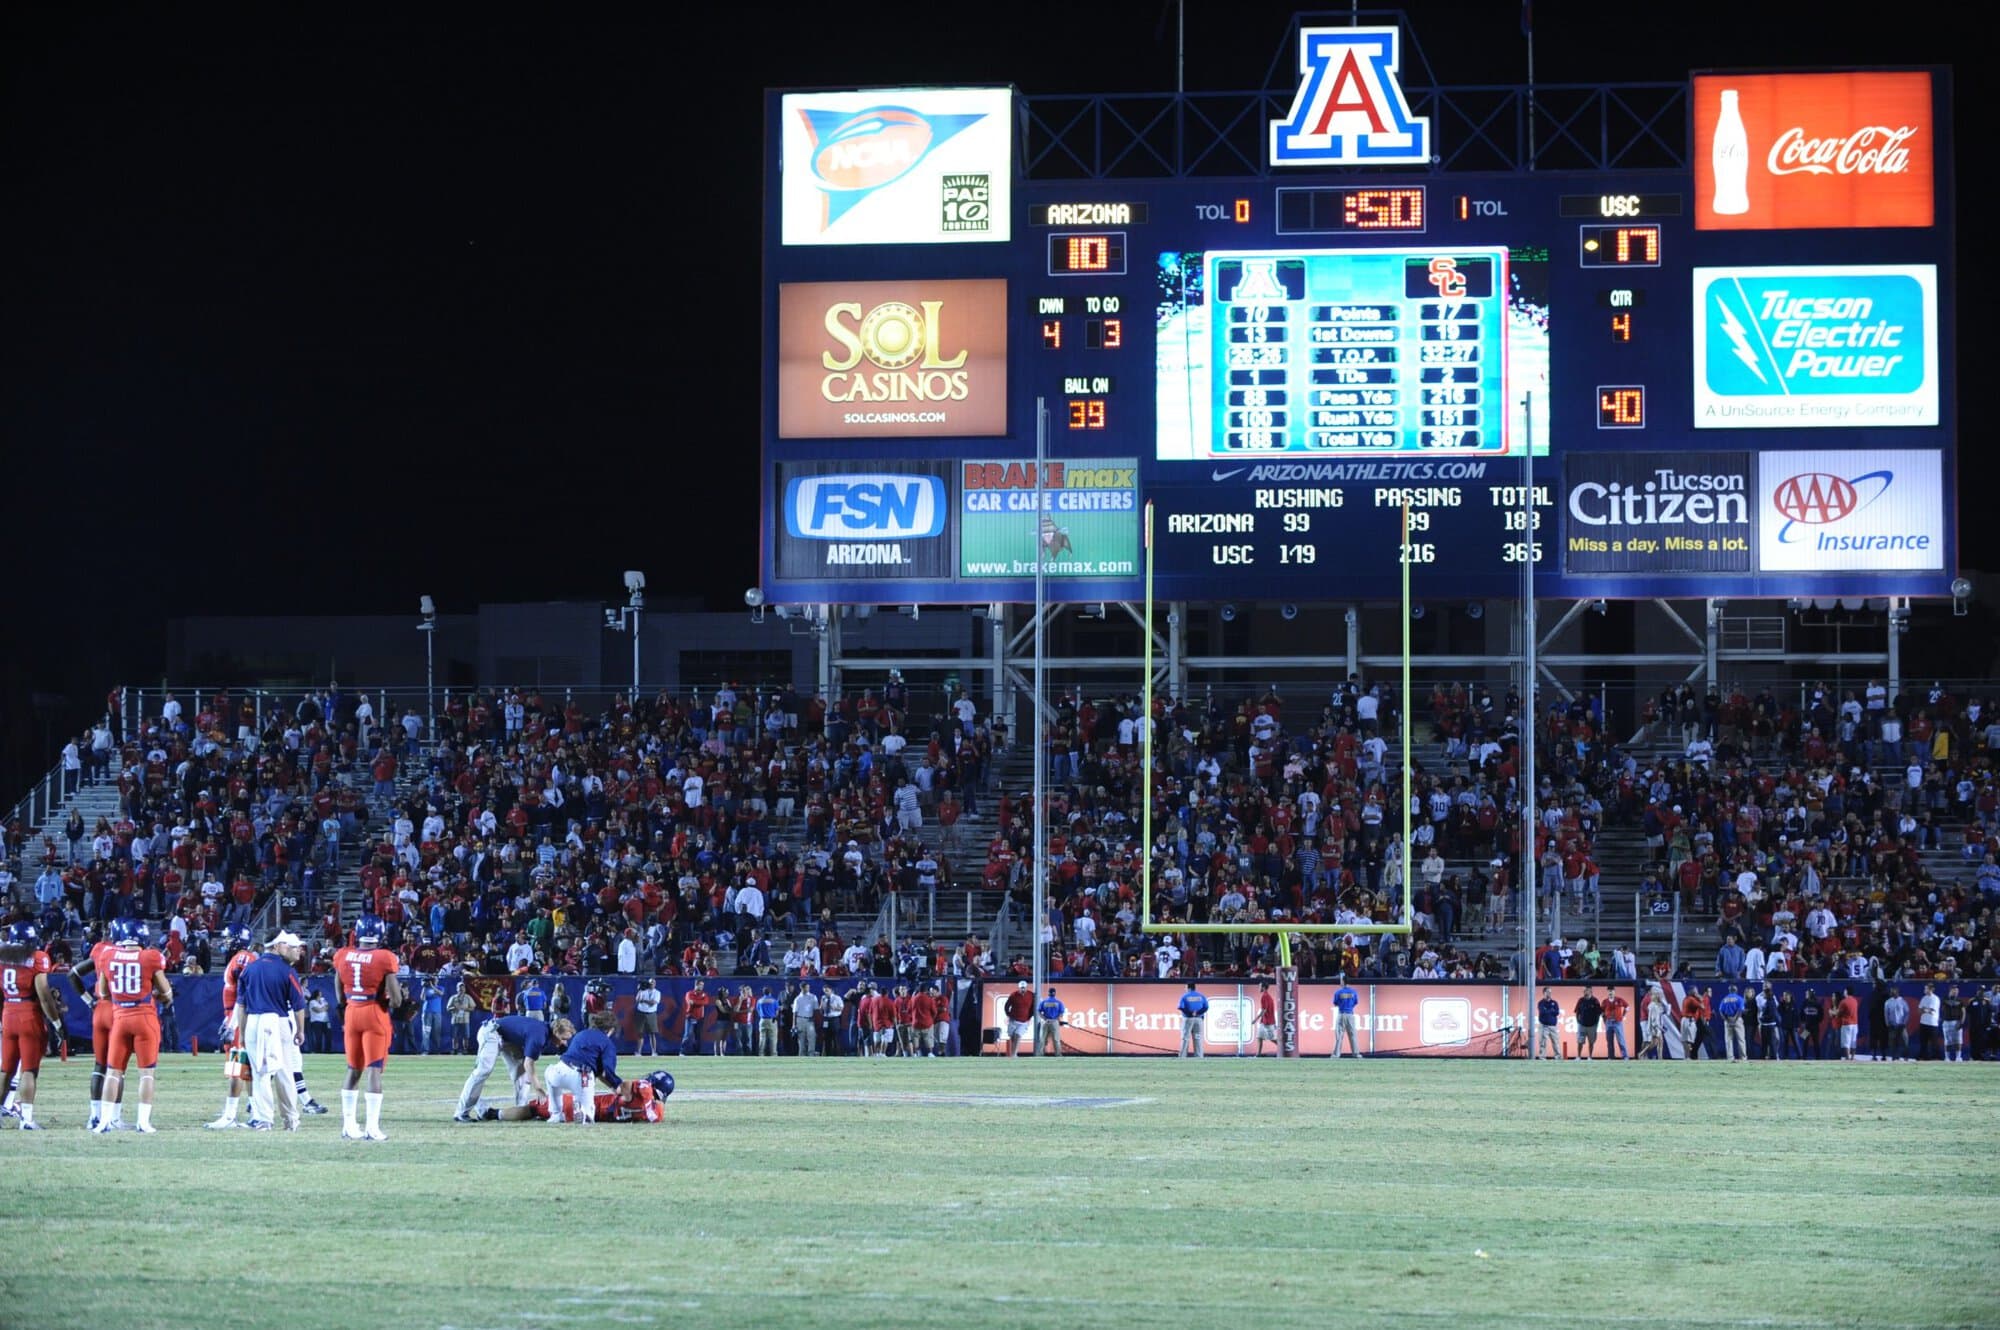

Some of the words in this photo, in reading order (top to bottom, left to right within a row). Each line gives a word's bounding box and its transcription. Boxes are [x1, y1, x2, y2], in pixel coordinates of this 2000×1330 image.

[1270, 26, 1429, 166] A
[1767, 126, 1918, 175] Coca-Cola
[943, 187, 988, 201] PAC
[943, 202, 988, 221] 10
[1048, 205, 1129, 224] ARIZONA
[1196, 205, 1230, 220] TOL
[1472, 201, 1507, 216] TOL
[1600, 196, 1640, 216] USC
[1068, 238, 1107, 269] 10
[1617, 229, 1658, 262] 17
[1039, 298, 1063, 313] DWN
[1086, 298, 1100, 313] TO
[1103, 298, 1119, 313] GO
[1610, 290, 1632, 306] QTR
[1760, 289, 1873, 320] Tucson
[1244, 304, 1269, 322] 10
[1330, 306, 1380, 321] Points
[1436, 303, 1461, 320] 17
[822, 300, 968, 371] SOL
[1043, 321, 1061, 348] 4
[1103, 320, 1121, 347] 3
[1313, 327, 1338, 342] 1st
[1340, 326, 1393, 341] Downs
[1612, 313, 1630, 340] 4
[1771, 319, 1904, 348] Electric
[1331, 349, 1379, 363] T.O.P.
[1785, 349, 1904, 378] Power
[1249, 369, 1259, 386] 1
[1336, 368, 1368, 383] TDs
[1441, 367, 1454, 383] 2
[821, 371, 968, 402] CASINOS
[1065, 378, 1090, 394] BALL
[1093, 378, 1108, 393] ON
[1319, 390, 1358, 405] Pass
[1361, 390, 1392, 405] Yds
[1601, 391, 1641, 423] 40
[844, 411, 945, 424] SOLCASINOS.COM
[1068, 401, 1105, 428] 39
[1318, 411, 1360, 426] Rush
[1362, 410, 1393, 426] Yds
[1706, 405, 1716, 416] A
[1721, 404, 1795, 417] UniSource
[1800, 403, 1850, 418] Energy
[1318, 431, 1358, 447] Total
[1361, 431, 1393, 447] Yds
[1066, 469, 1136, 489] max
[1248, 463, 1486, 481] ARIZONAATHLETICS.COM
[1655, 469, 1744, 491] Tucson
[810, 482, 920, 530] FSN
[967, 493, 1002, 511] CAR
[1058, 492, 1133, 510] CENTERS
[1255, 489, 1343, 508] RUSHING
[1375, 487, 1461, 507] PASSING
[1489, 487, 1553, 506] TOTAL
[1568, 482, 1748, 525] Citizen
[1784, 474, 1850, 523] AAA
[1168, 513, 1254, 533] ARIZONA
[1283, 513, 1310, 532] 99
[1569, 538, 1608, 552] Miss
[1612, 541, 1622, 552] a
[1626, 537, 1660, 553] day.
[1665, 537, 1703, 551] Miss
[1709, 540, 1718, 551] a
[1722, 536, 1748, 551] lot.
[1817, 531, 1930, 551] Insurance
[827, 544, 902, 565] ARIZONA
[1213, 545, 1254, 564] USC
[1503, 543, 1543, 562] 365
[282, 897, 297, 907] 26
[1653, 902, 1669, 912] 29
[3, 968, 20, 996] 8
[109, 961, 142, 994] 38
[350, 963, 364, 992] 1
[1063, 1007, 1109, 1029] tate
[1281, 971, 1297, 1051] WILDCATS
